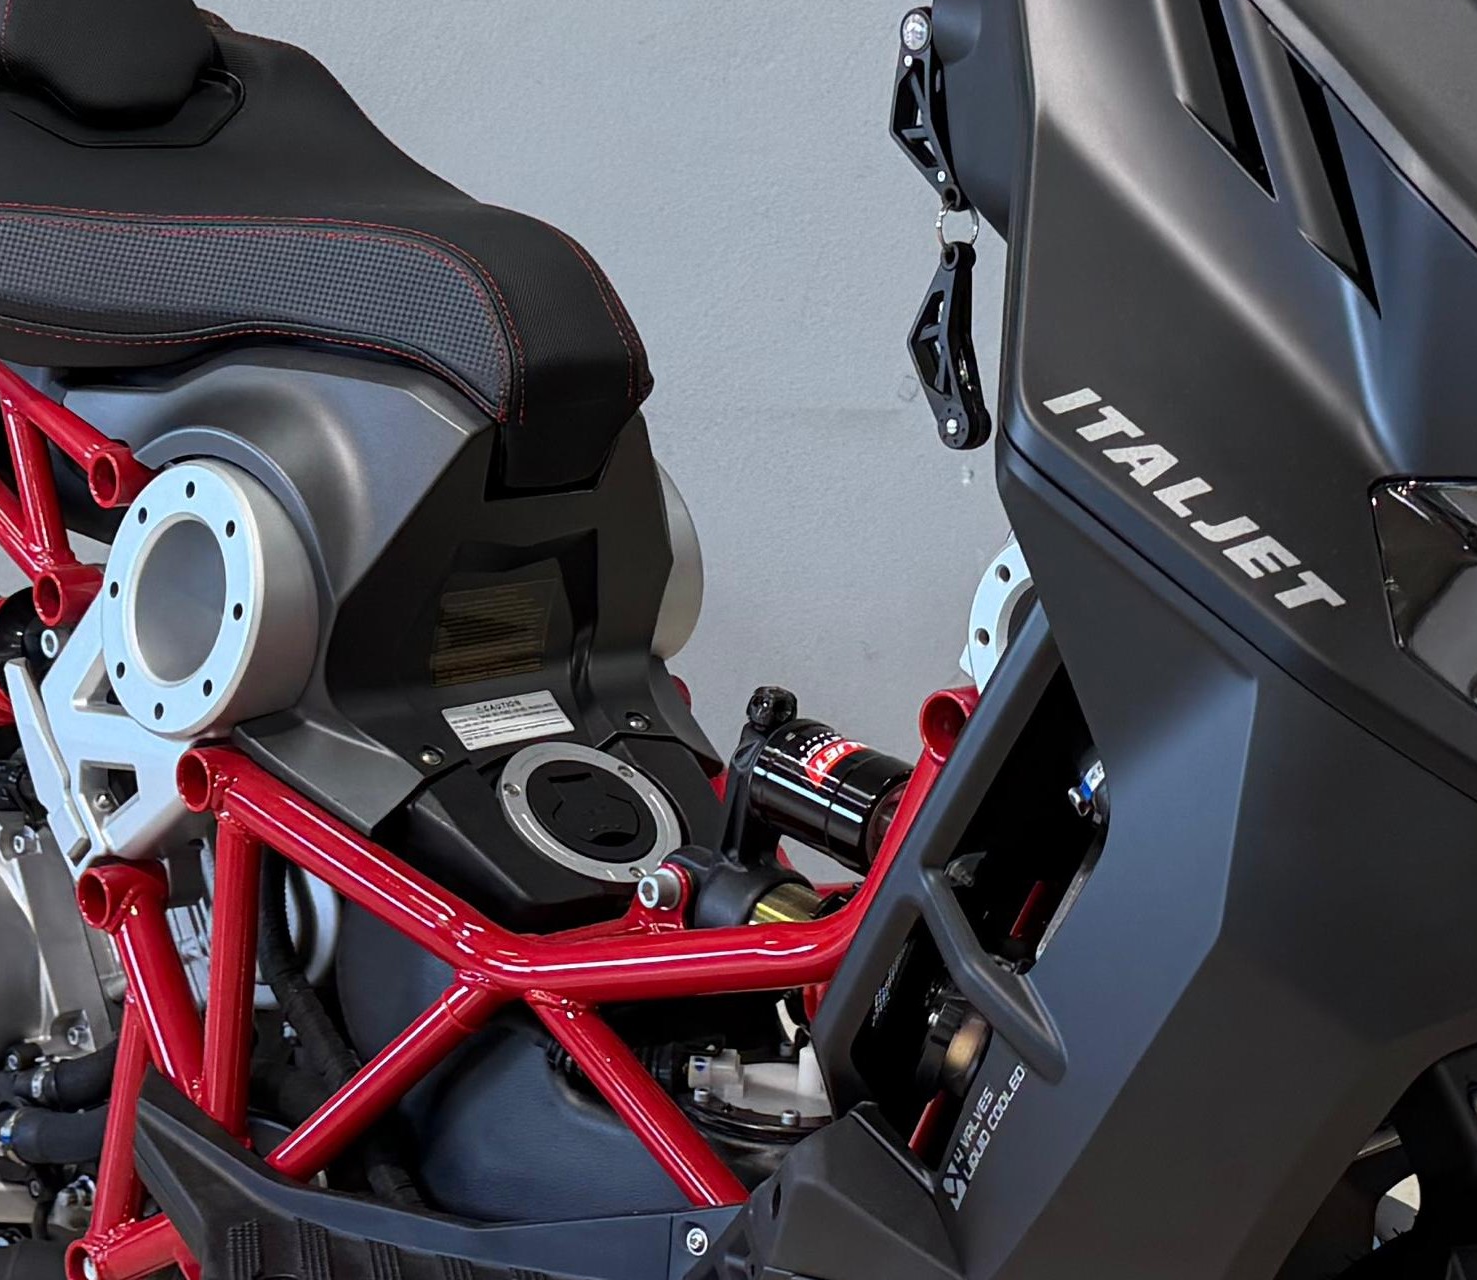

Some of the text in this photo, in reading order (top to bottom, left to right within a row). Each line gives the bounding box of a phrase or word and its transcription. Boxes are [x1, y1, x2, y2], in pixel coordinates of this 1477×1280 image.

[1042, 387, 1347, 610] ITALJET
[960, 1084, 994, 1149] VALVES
[962, 1063, 1026, 1181] LIQUID COOLED
